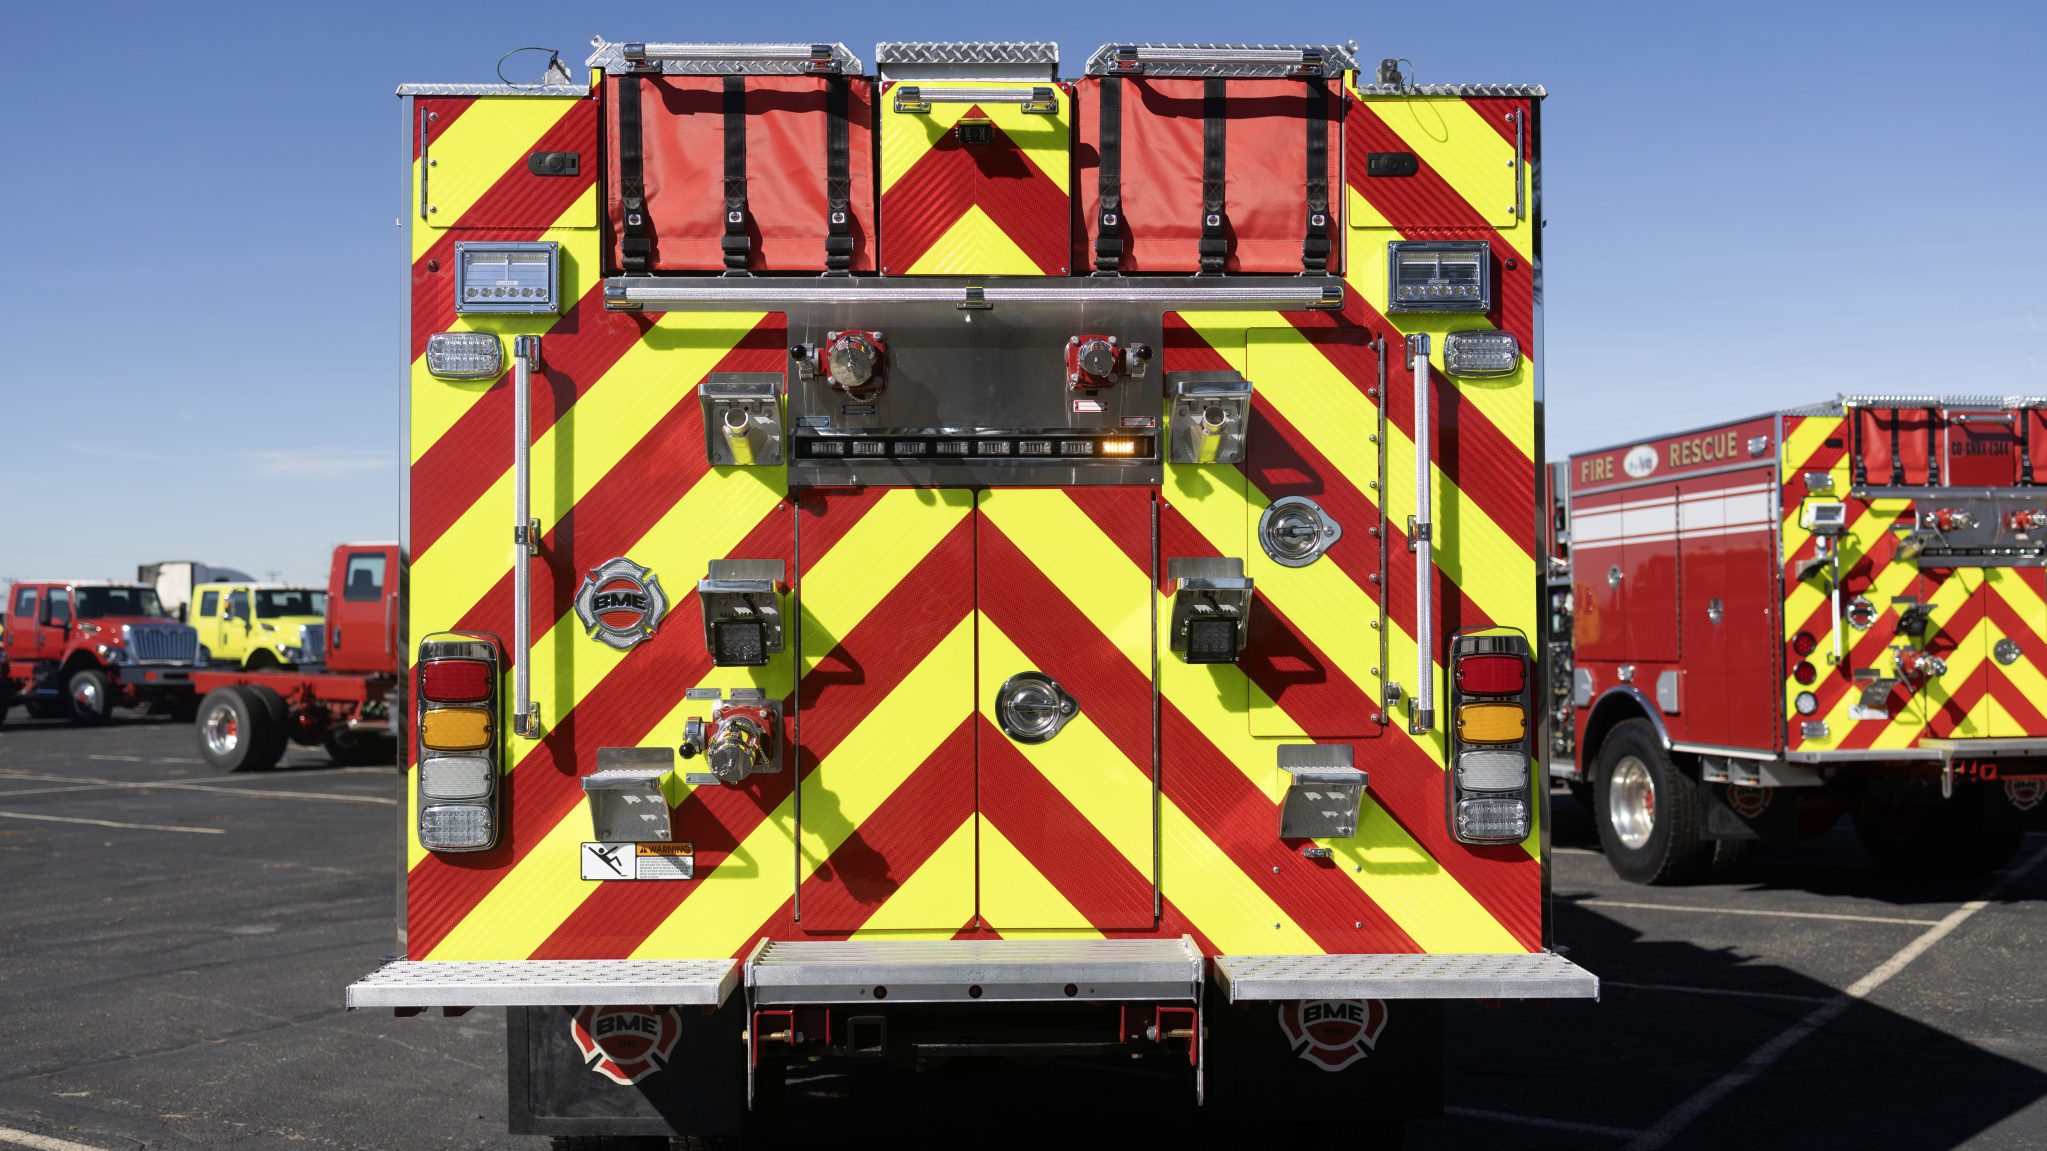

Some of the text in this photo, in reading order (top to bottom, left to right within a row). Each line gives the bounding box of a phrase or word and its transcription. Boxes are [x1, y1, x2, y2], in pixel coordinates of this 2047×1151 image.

[1581, 456, 1614, 483] FIRE
[1669, 432, 1738, 468] RESCUE
[594, 592, 646, 611] BME
[650, 845, 692, 854] WARNING
[1303, 1003, 1363, 1024] BME
[596, 1014, 657, 1036] BME
